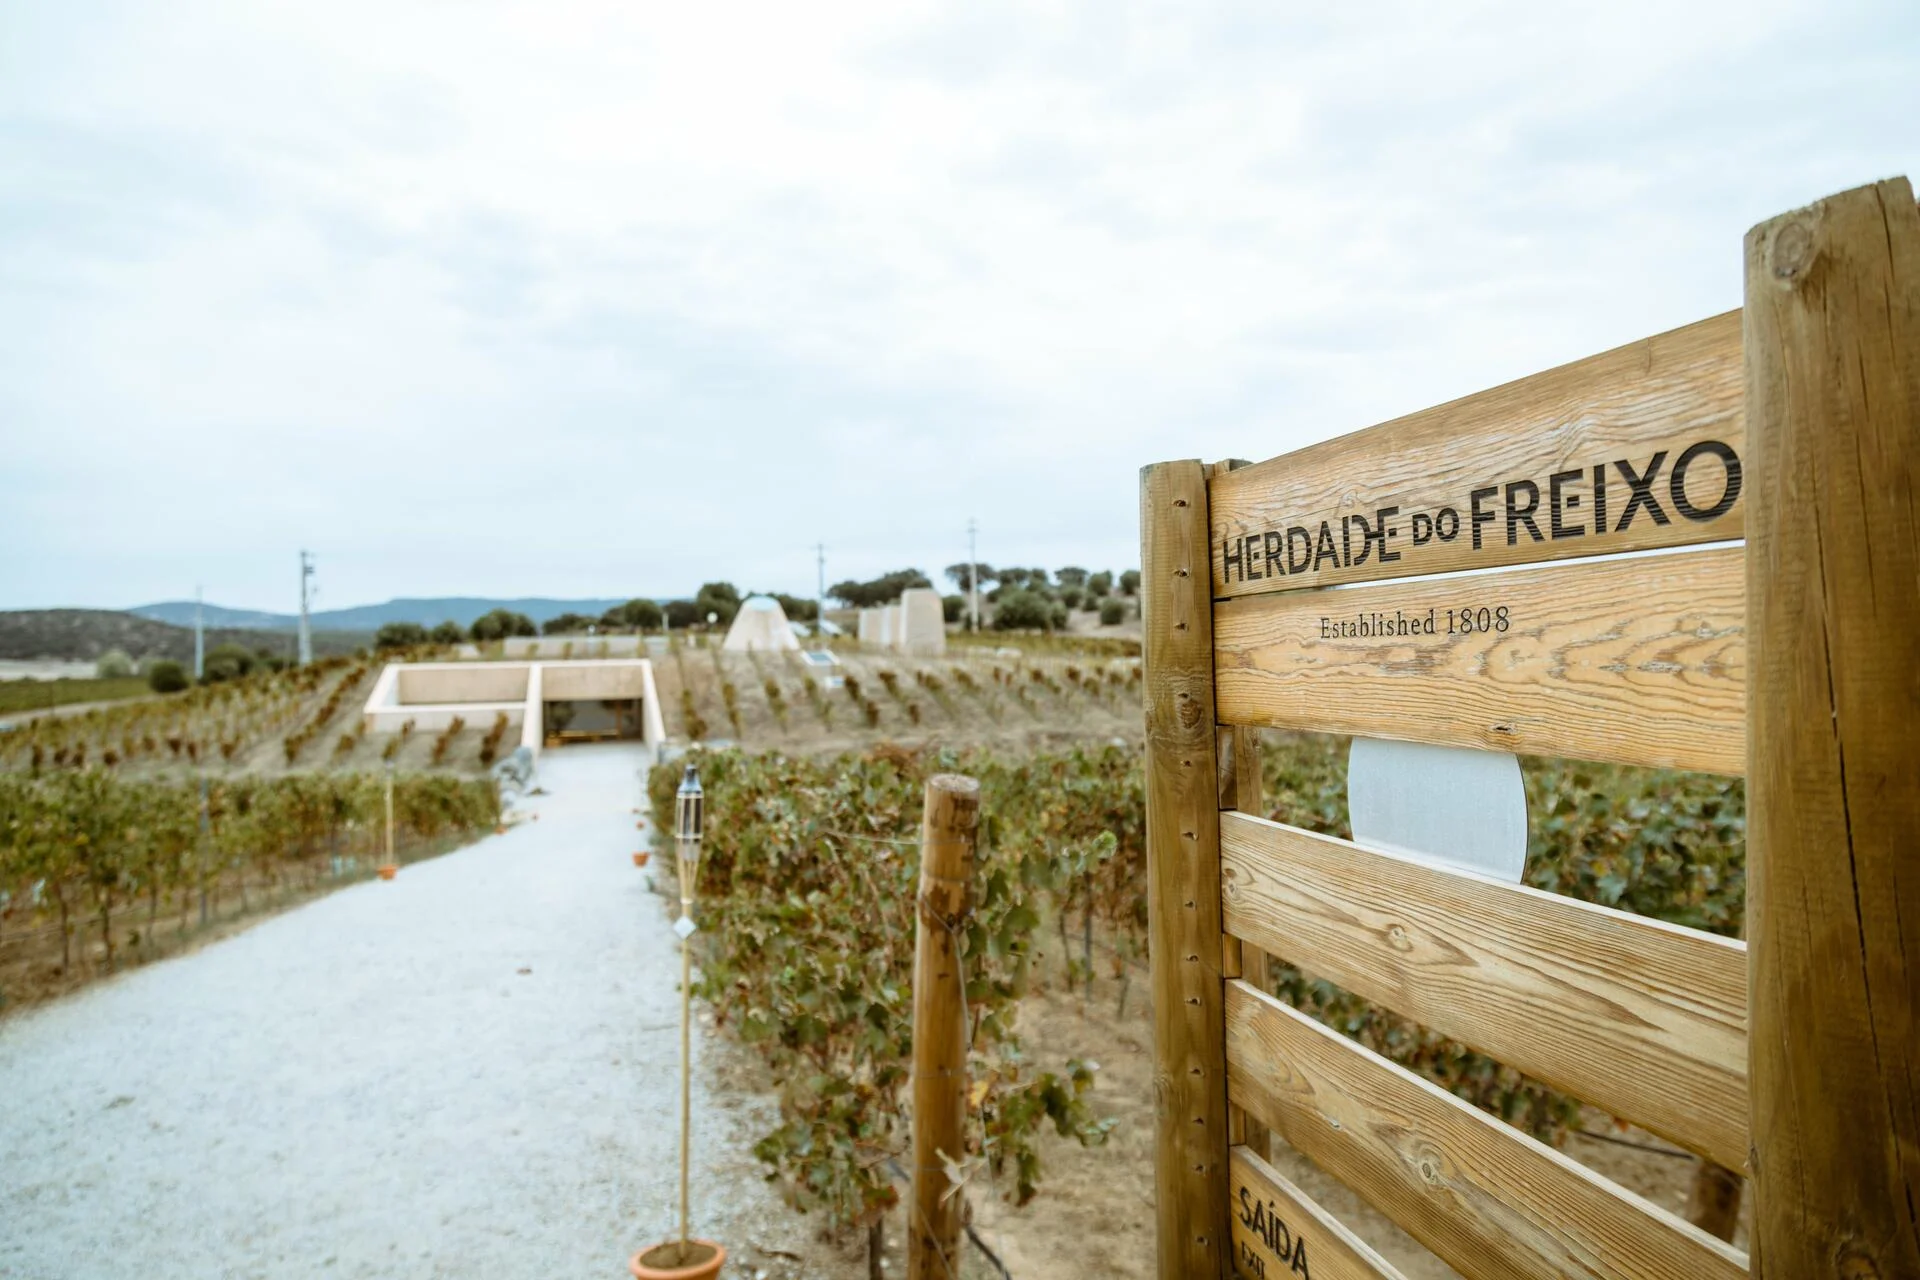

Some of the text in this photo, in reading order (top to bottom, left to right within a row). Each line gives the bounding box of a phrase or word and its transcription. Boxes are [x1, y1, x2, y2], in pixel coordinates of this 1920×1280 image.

[1412, 507, 1460, 546] DO
[1470, 439, 1743, 551] FREIXO
[1320, 605, 1510, 639] Established 1808
[1239, 1186, 1310, 1280] SAÍDA
